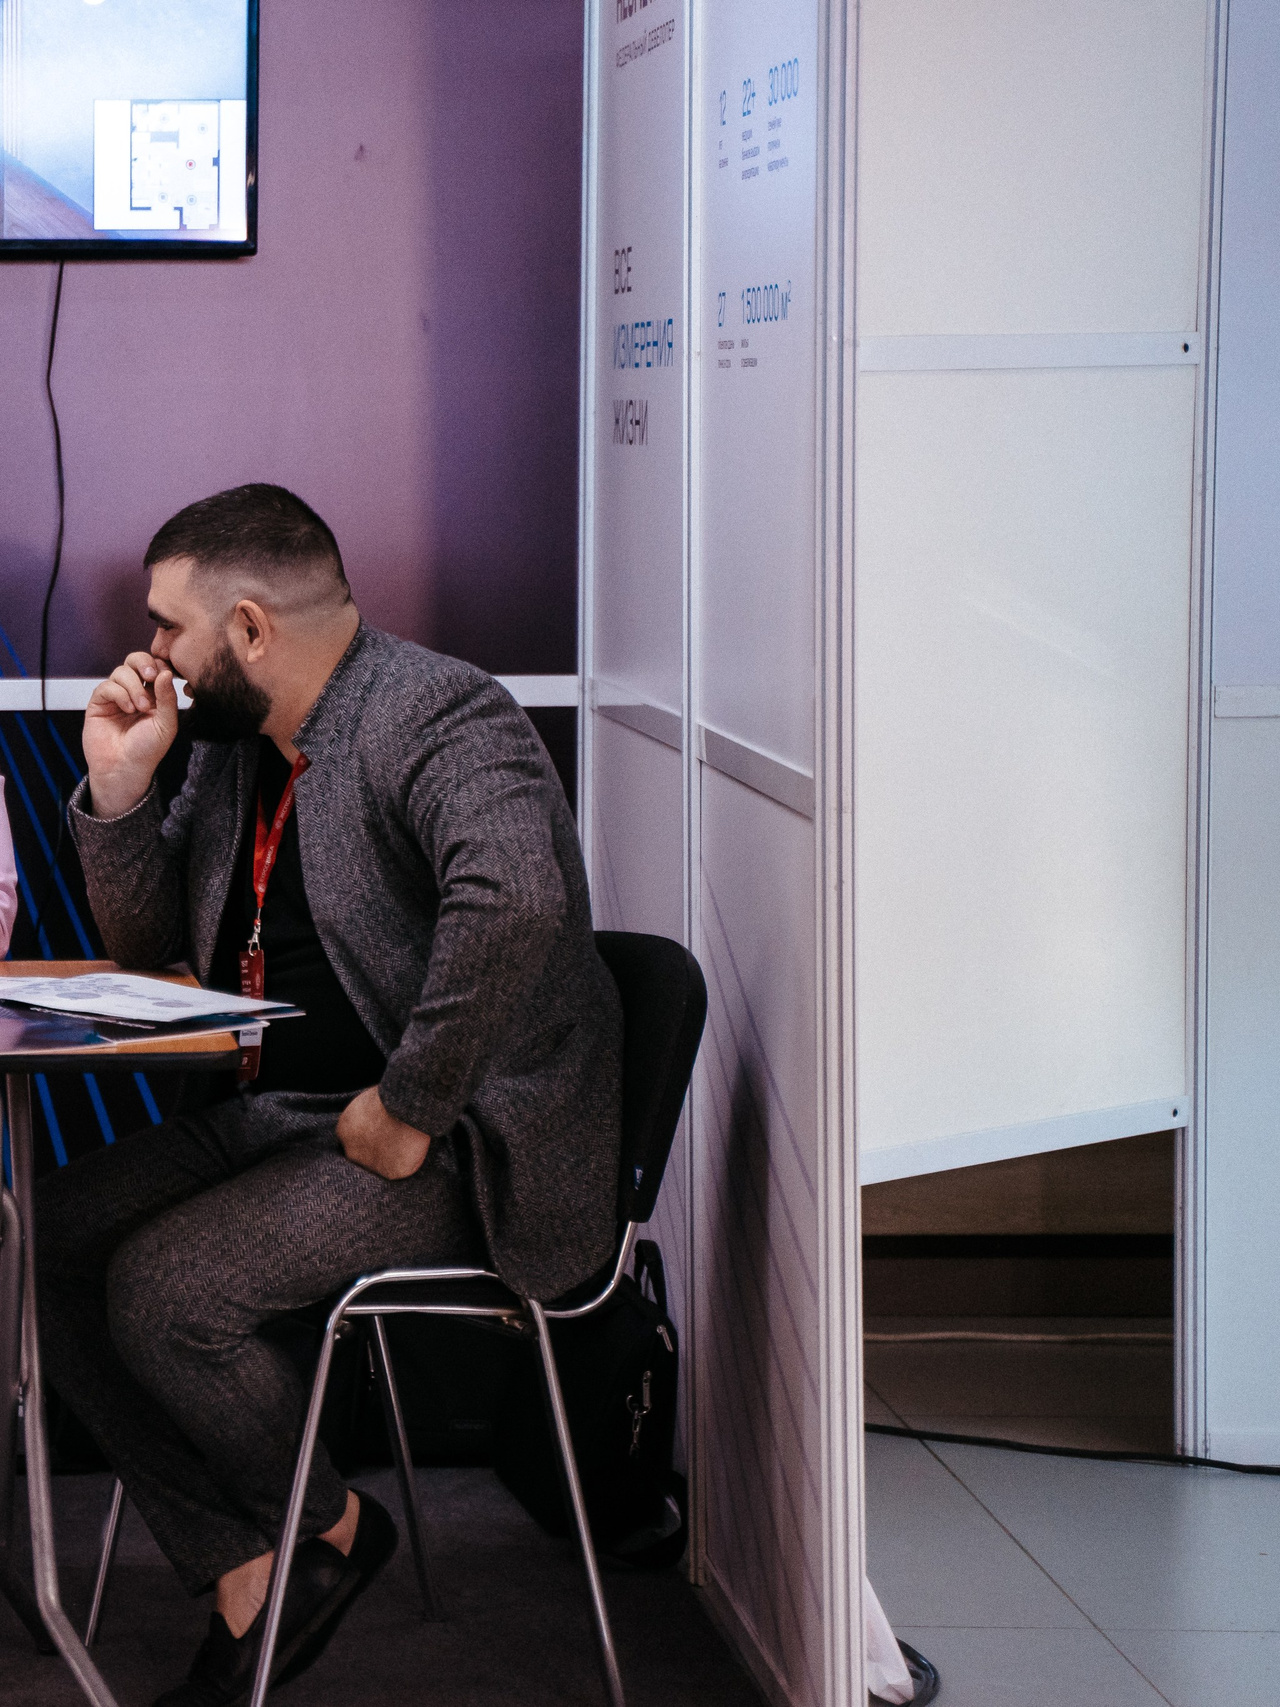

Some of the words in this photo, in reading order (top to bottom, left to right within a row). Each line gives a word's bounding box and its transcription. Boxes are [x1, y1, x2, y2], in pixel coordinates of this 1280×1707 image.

[742, 78, 756, 117] 22+
[614, 246, 632, 294] ВСЕ
[718, 291, 726, 327] 27
[613, 318, 674, 369] ИЗМЕРЕНИЯ
[612, 399, 649, 446] ЖИЗНИ
